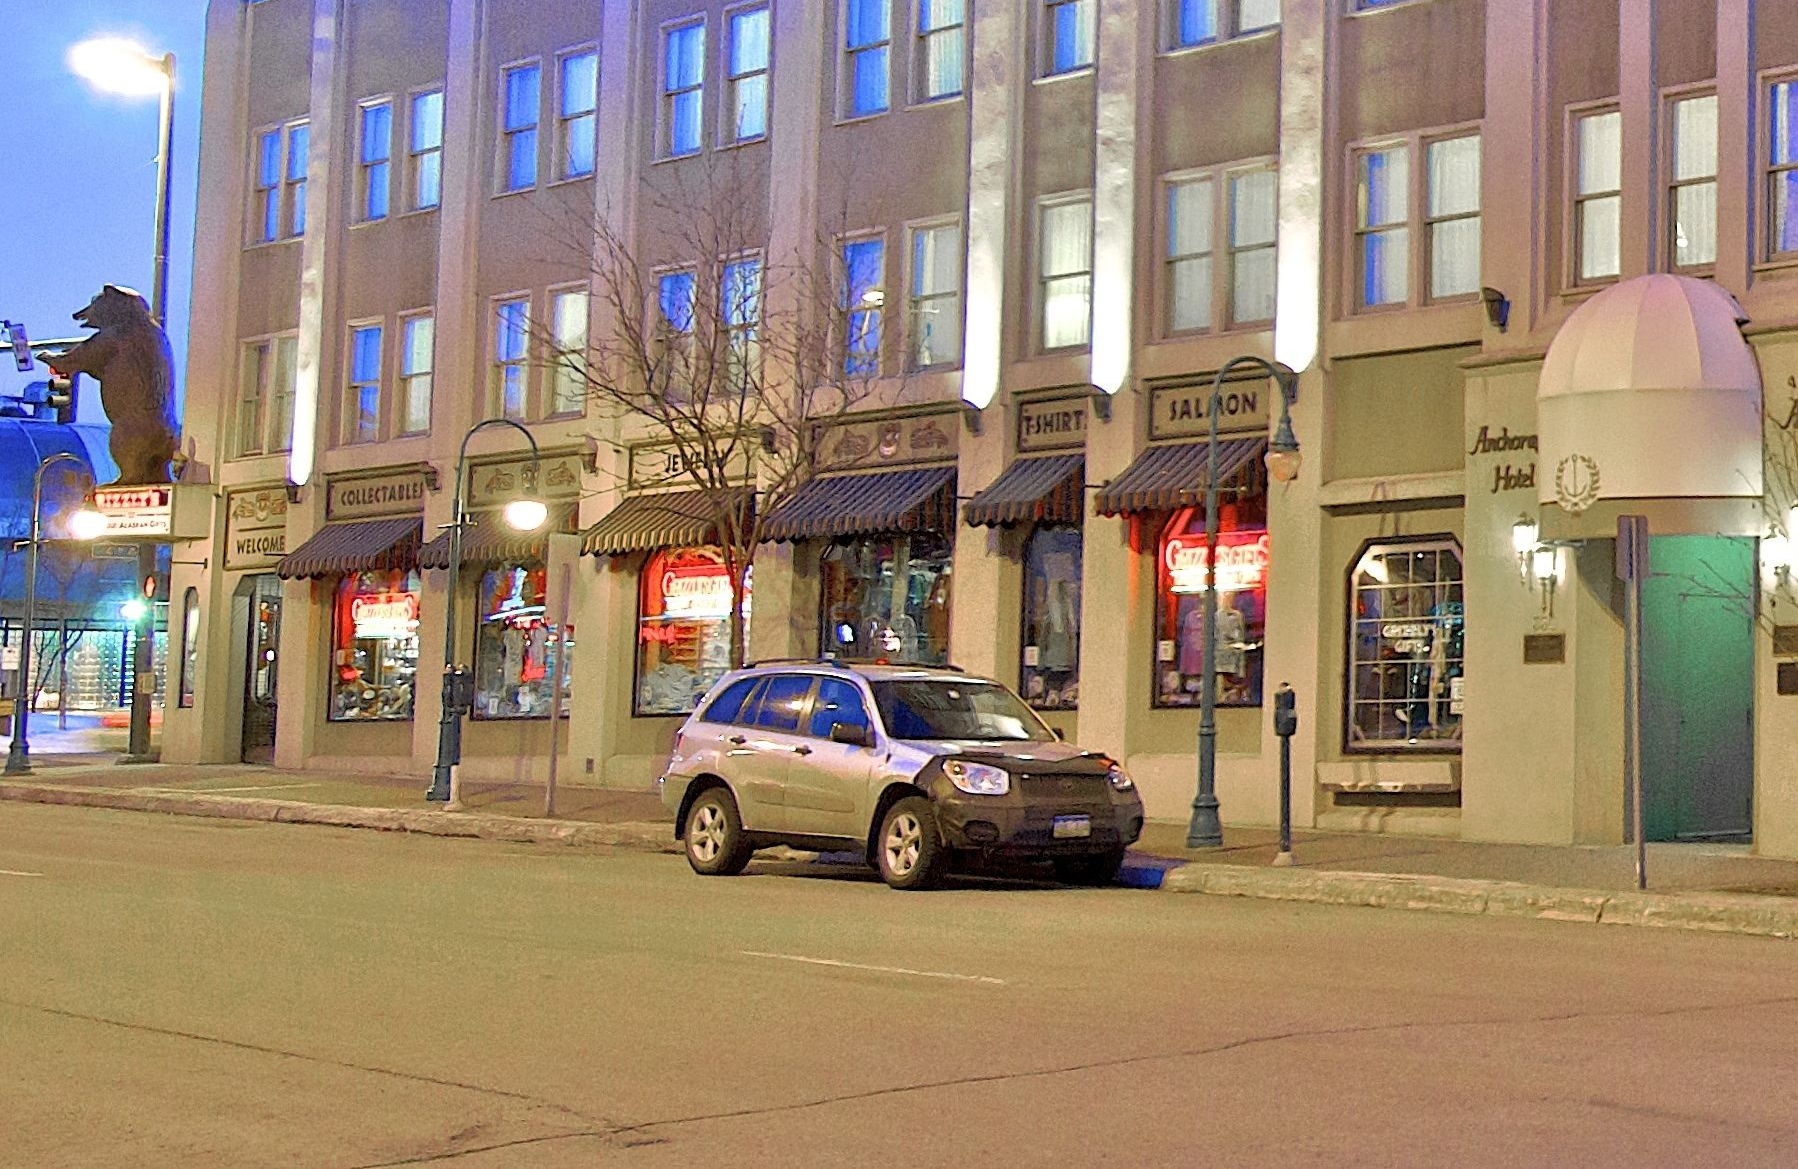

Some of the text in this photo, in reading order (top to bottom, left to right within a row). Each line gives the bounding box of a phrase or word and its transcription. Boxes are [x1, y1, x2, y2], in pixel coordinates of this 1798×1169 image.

[1469, 425, 1538, 456] Anchora
[1491, 464, 1535, 494] Hotel
[236, 534, 286, 555] WELCOME
